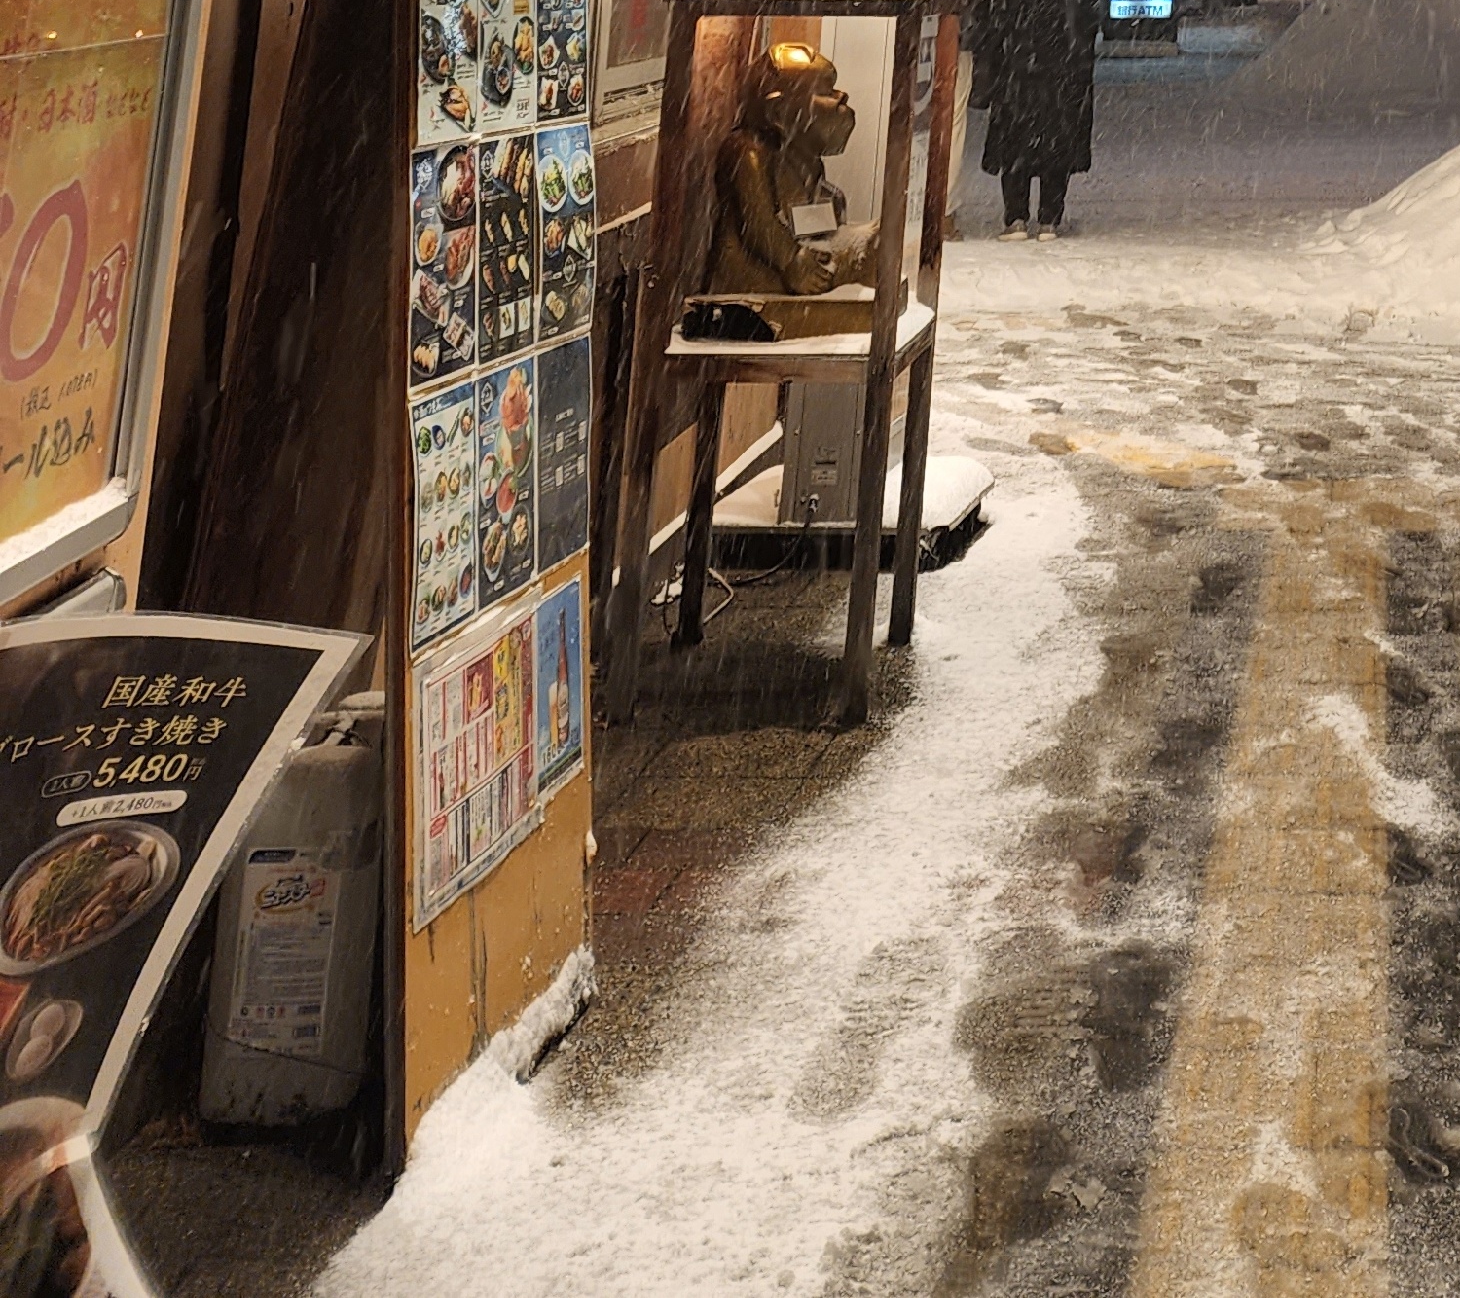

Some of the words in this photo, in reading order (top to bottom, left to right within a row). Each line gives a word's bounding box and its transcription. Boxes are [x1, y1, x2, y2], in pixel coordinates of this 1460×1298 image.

[0, 406, 96, 480] ール込み
[101, 672, 248, 710] 国産和牛
